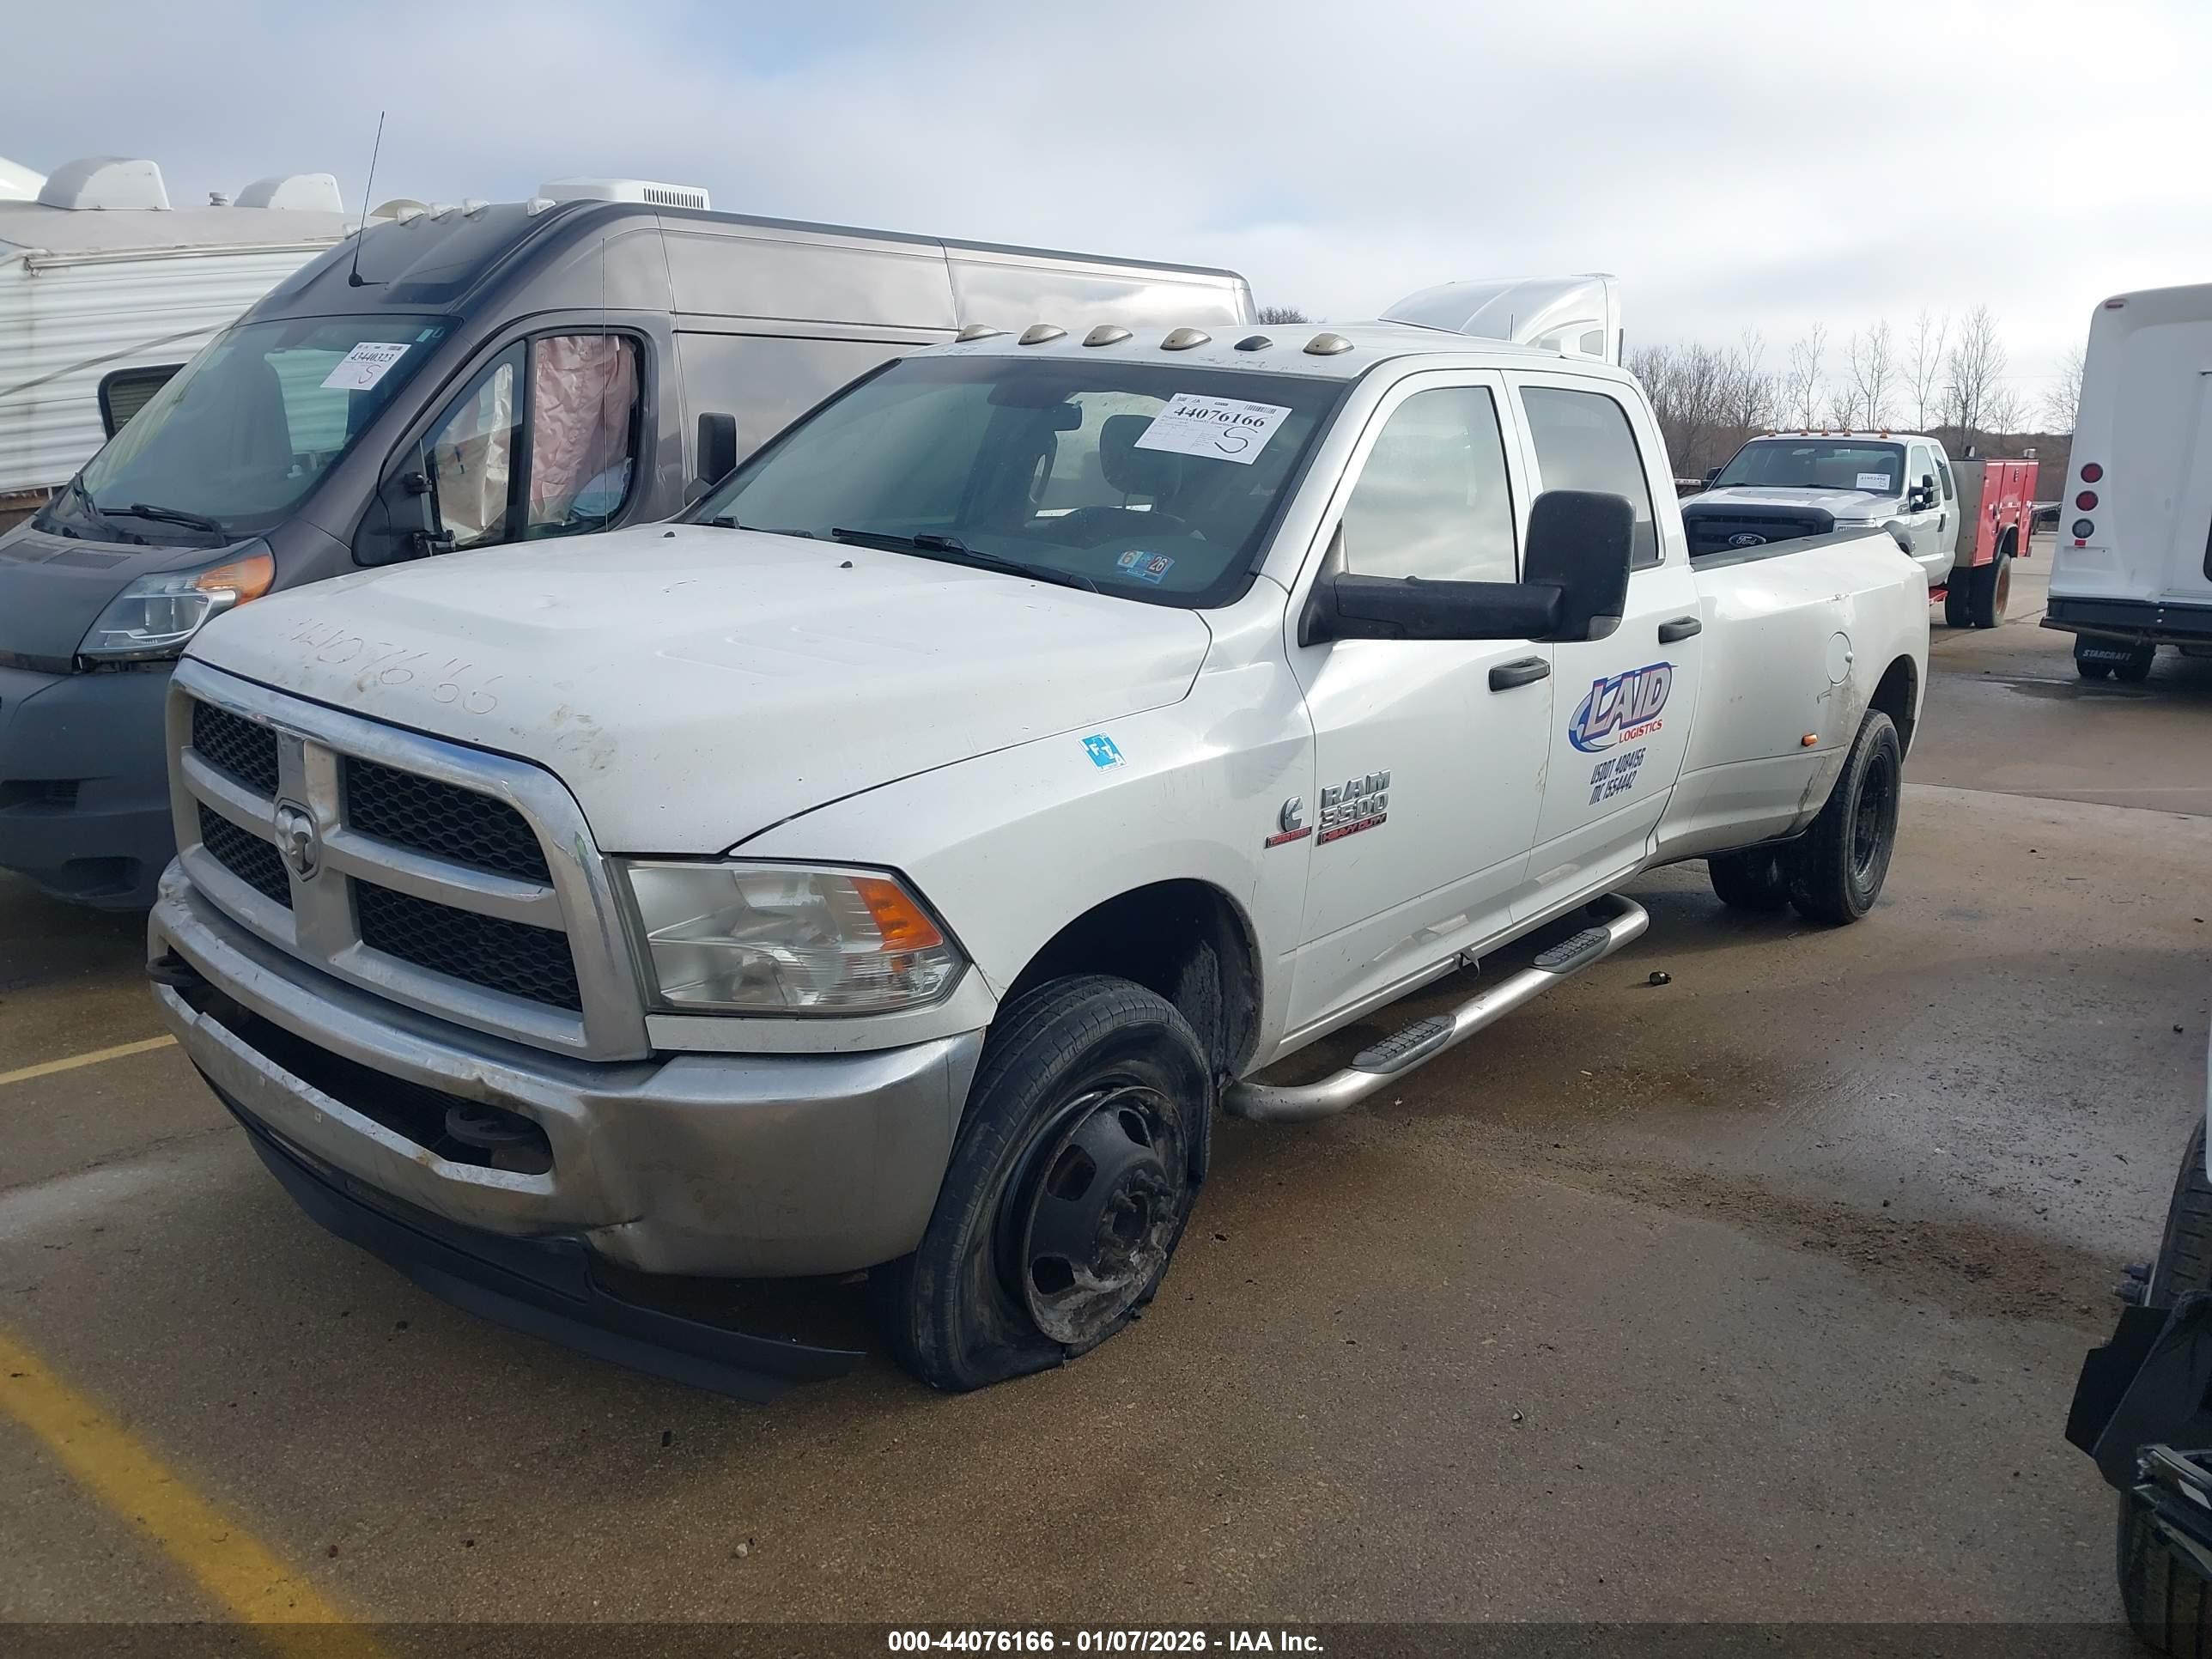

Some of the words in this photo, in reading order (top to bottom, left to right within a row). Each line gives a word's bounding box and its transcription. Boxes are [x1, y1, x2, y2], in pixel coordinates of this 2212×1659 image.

[1174, 406, 1267, 428] 44076166
[1214, 426, 1258, 453] S
[1149, 556, 1168, 572] 26
[1580, 662, 1673, 743] LAID
[1619, 719, 1663, 744] LOGISTICS
[1590, 758, 1616, 785] USDOT
[1321, 769, 1391, 809] RAM
[1318, 791, 1389, 830] 3500
[1323, 823, 1358, 842] HEAVY
[1358, 815, 1387, 831] DUTY
